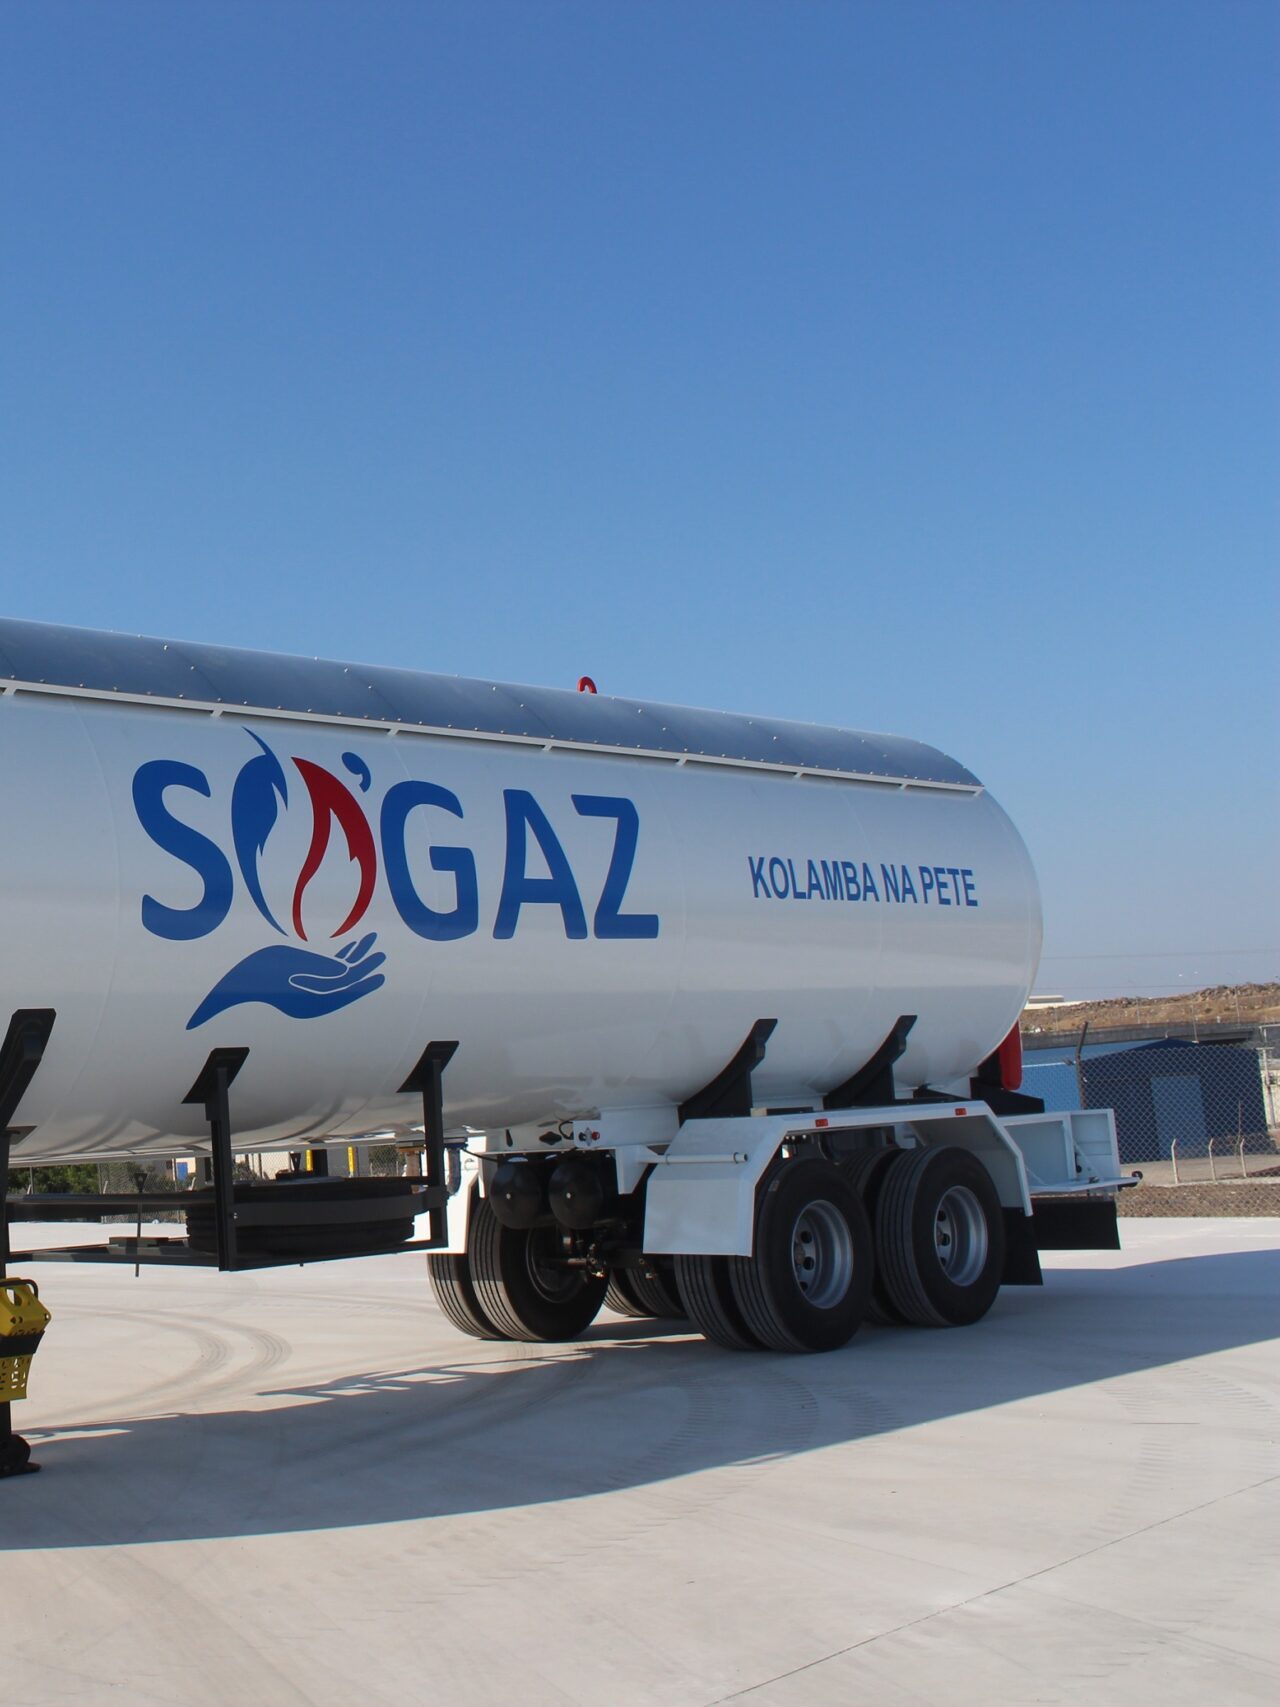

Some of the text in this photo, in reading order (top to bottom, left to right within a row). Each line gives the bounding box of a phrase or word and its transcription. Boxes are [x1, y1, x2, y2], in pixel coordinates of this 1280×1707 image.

[748, 856, 979, 907] KOLAMBA NA PETE
